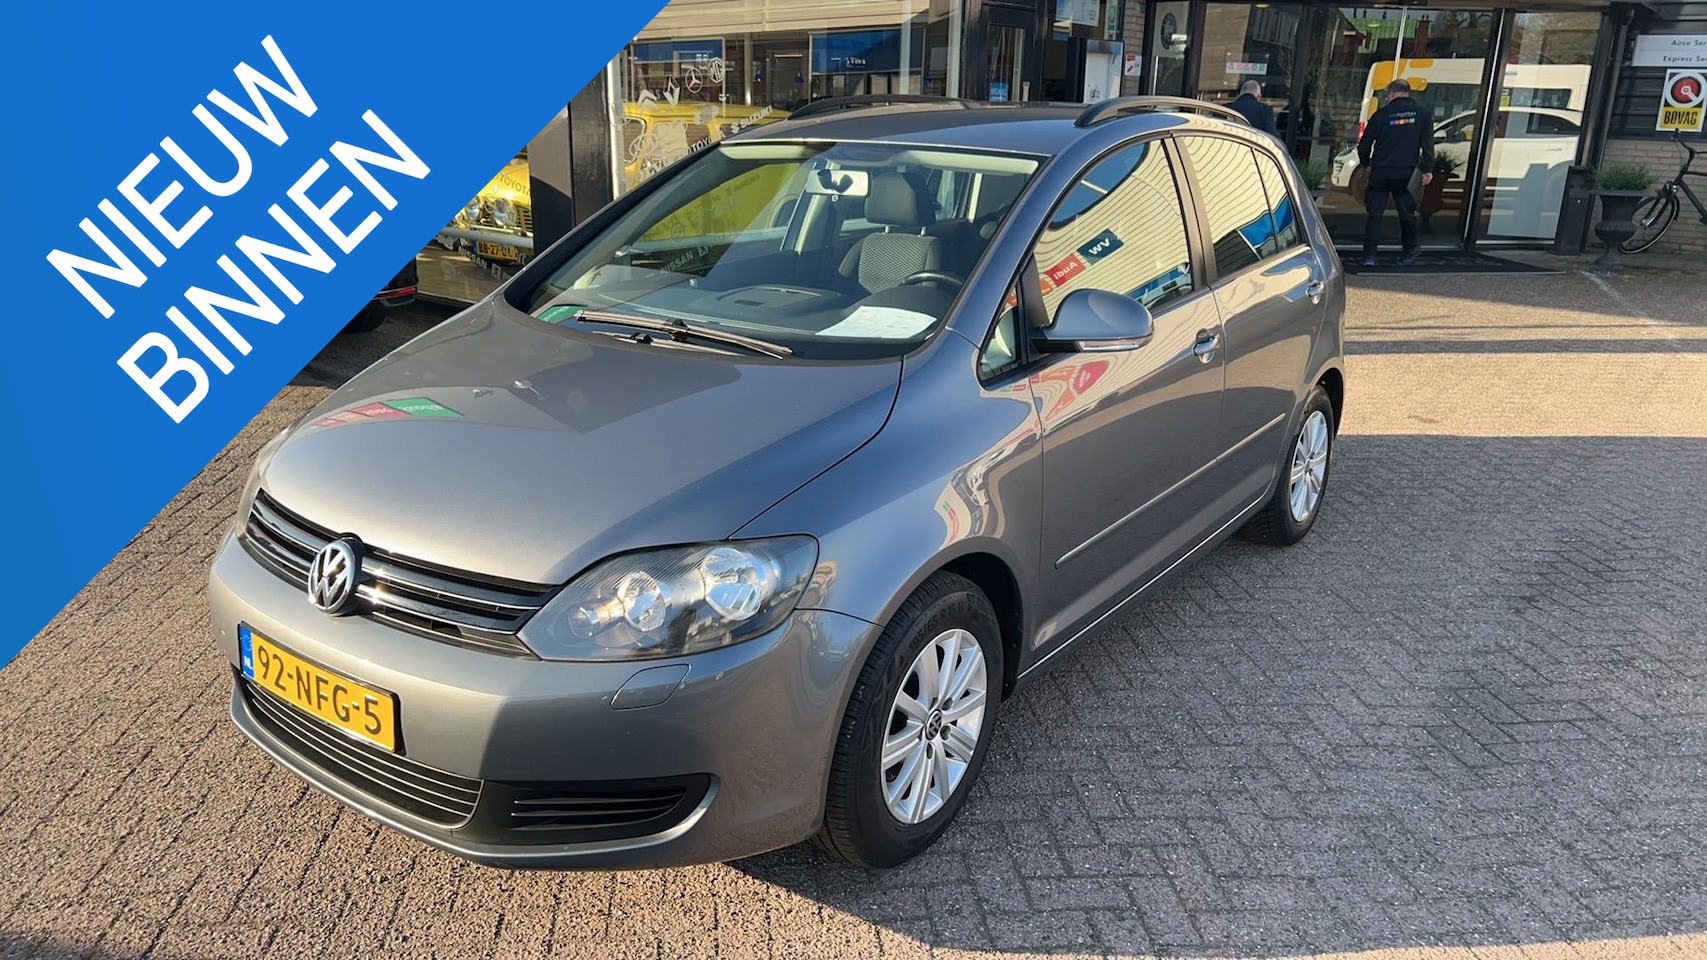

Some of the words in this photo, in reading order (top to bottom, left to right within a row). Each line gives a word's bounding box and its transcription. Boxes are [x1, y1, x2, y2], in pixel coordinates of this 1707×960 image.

[1671, 39, 1691, 47] Airco
[1663, 55, 1692, 63] Express
[740, 104, 774, 128] SUZUKI
[1663, 110, 1698, 126] BOVAG
[690, 130, 726, 153] TOYOA
[459, 245, 487, 270] NISSAN
[243, 654, 254, 670] NL
[257, 645, 382, 735] 92-NFG-5
